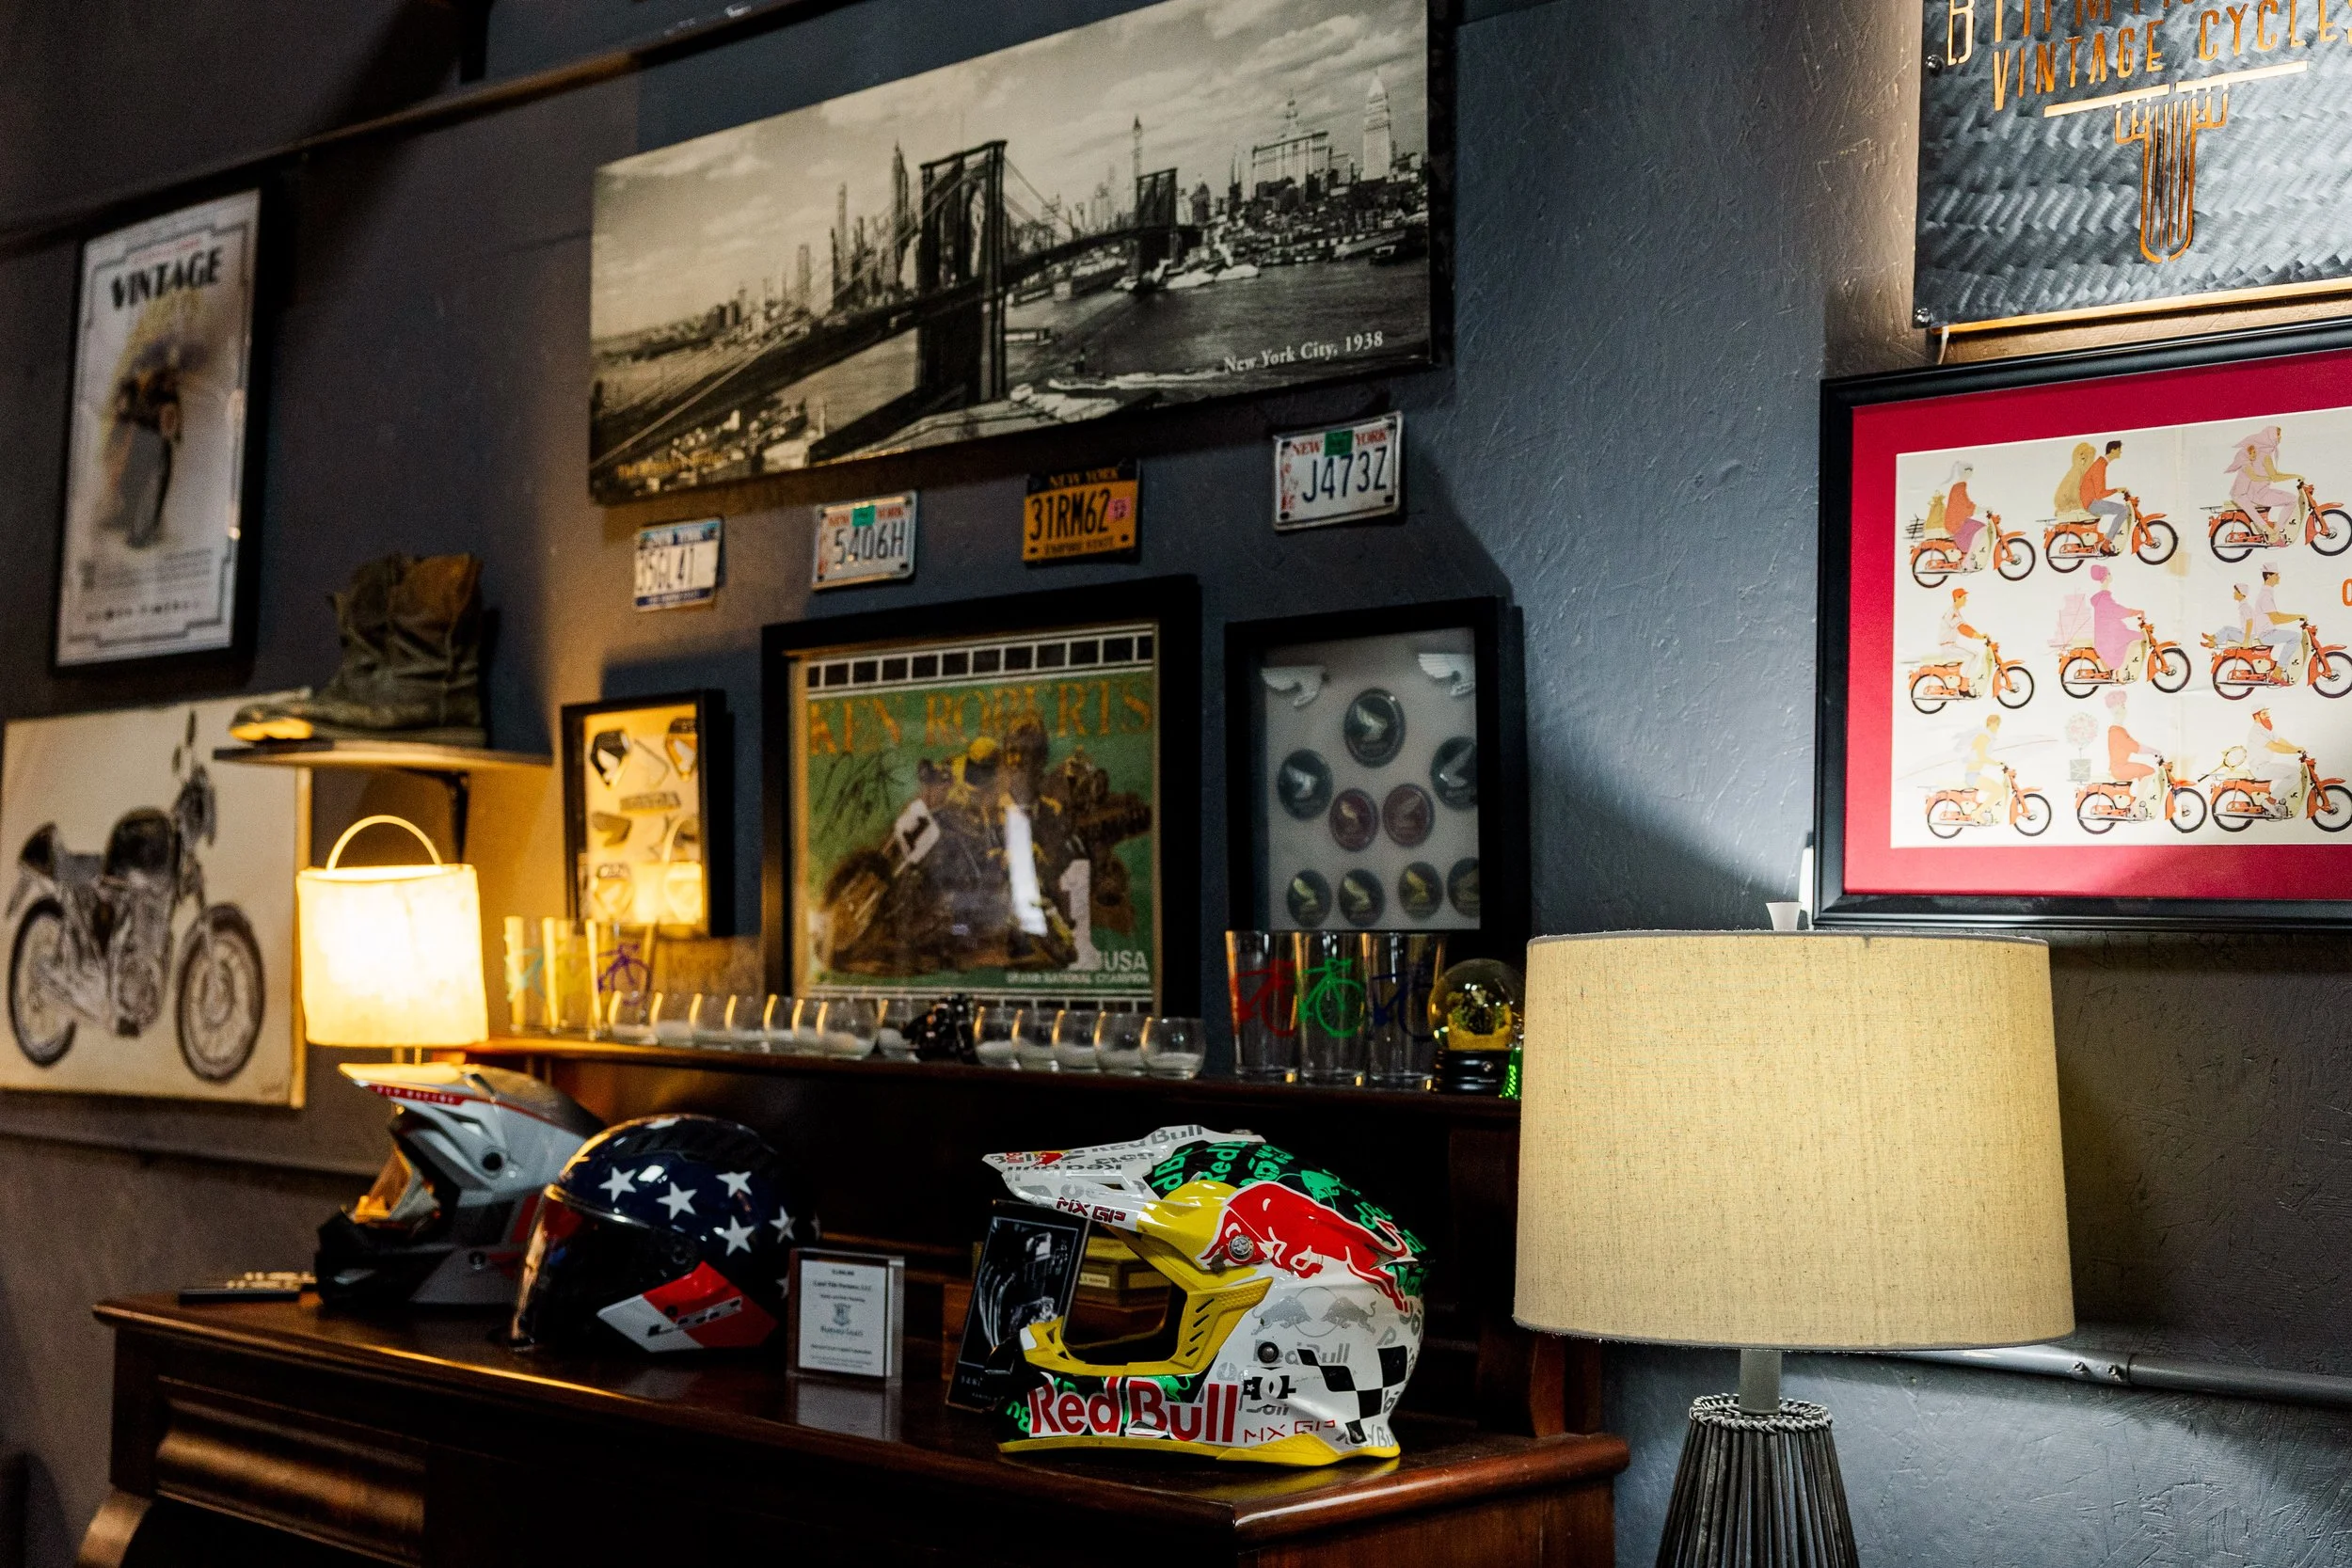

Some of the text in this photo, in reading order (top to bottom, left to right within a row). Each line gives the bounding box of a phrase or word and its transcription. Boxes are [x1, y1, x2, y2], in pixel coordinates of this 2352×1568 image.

[1993, 20, 2164, 111] VINTAGE
[2199, 0, 2352, 61] CYCLE
[111, 246, 222, 309] VINTAGE
[1223, 330, 1383, 374] New York City, 1938
[1291, 429, 1387, 455] NEW YORK
[1302, 445, 1388, 503] J473Z
[1030, 488, 1111, 541] 31RM62
[834, 519, 906, 565] 5406H
[809, 677, 1153, 755] KEN ROBERTS
[1104, 950, 1148, 972] USA
[1151, 1125, 1202, 1146] Bull
[1056, 1196, 1127, 1224] MX GP
[1029, 1375, 1238, 1443] Red Bull
